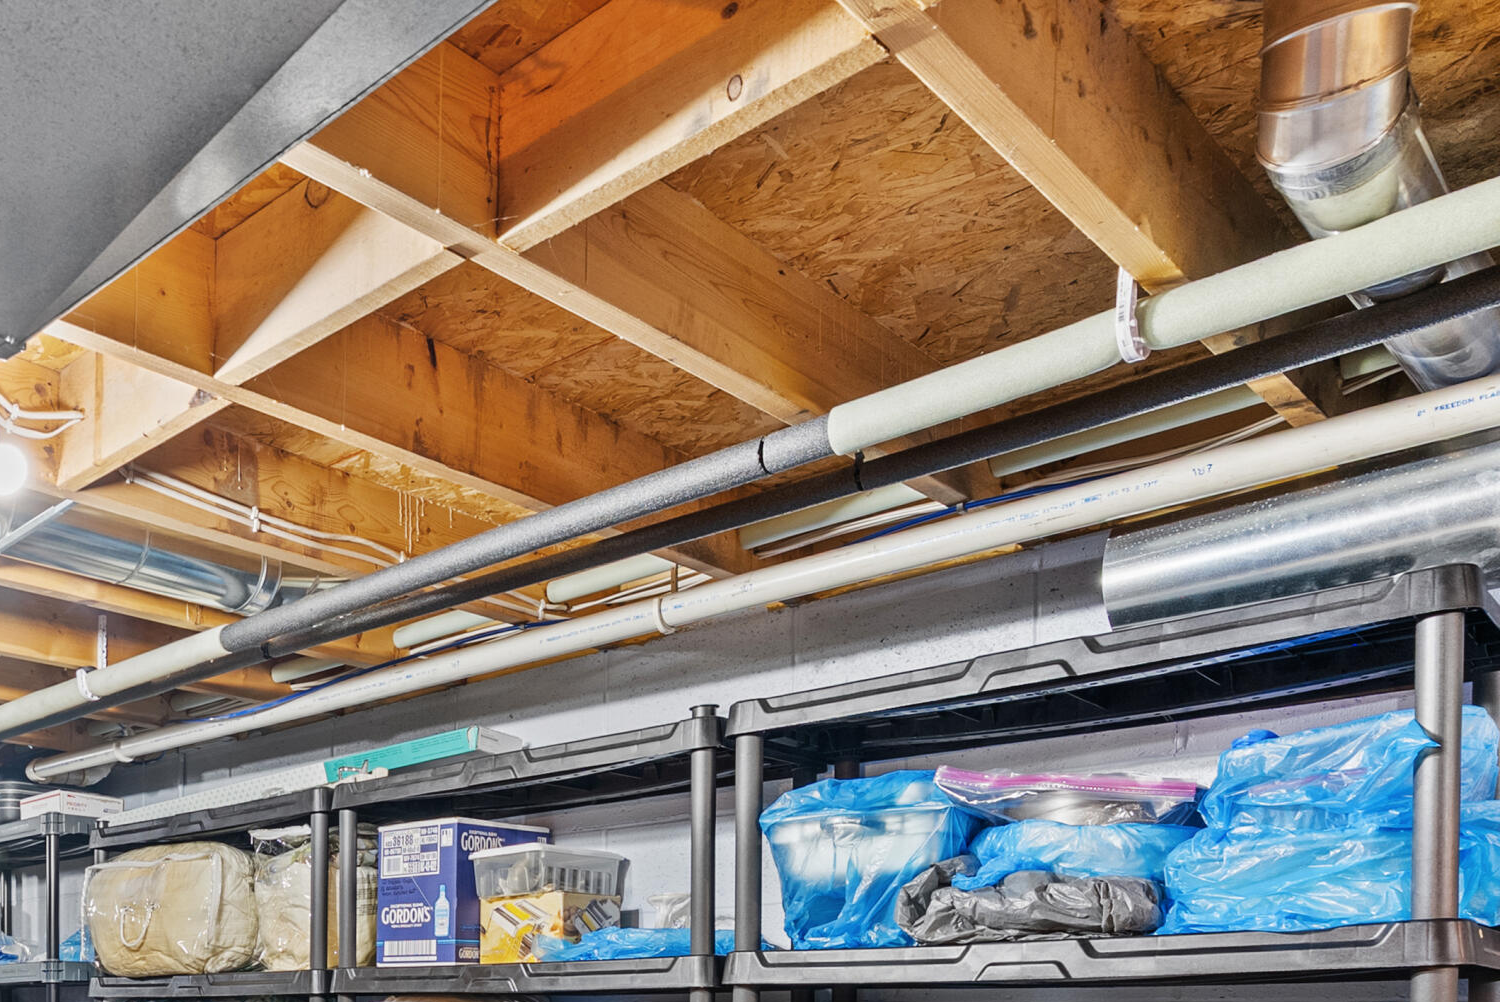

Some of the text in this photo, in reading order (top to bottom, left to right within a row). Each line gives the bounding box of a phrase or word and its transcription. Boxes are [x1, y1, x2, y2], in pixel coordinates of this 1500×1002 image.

[460, 831, 502, 851] GORDON'S
[381, 905, 431, 925] GORDON'S
[458, 947, 480, 959] GORDON
